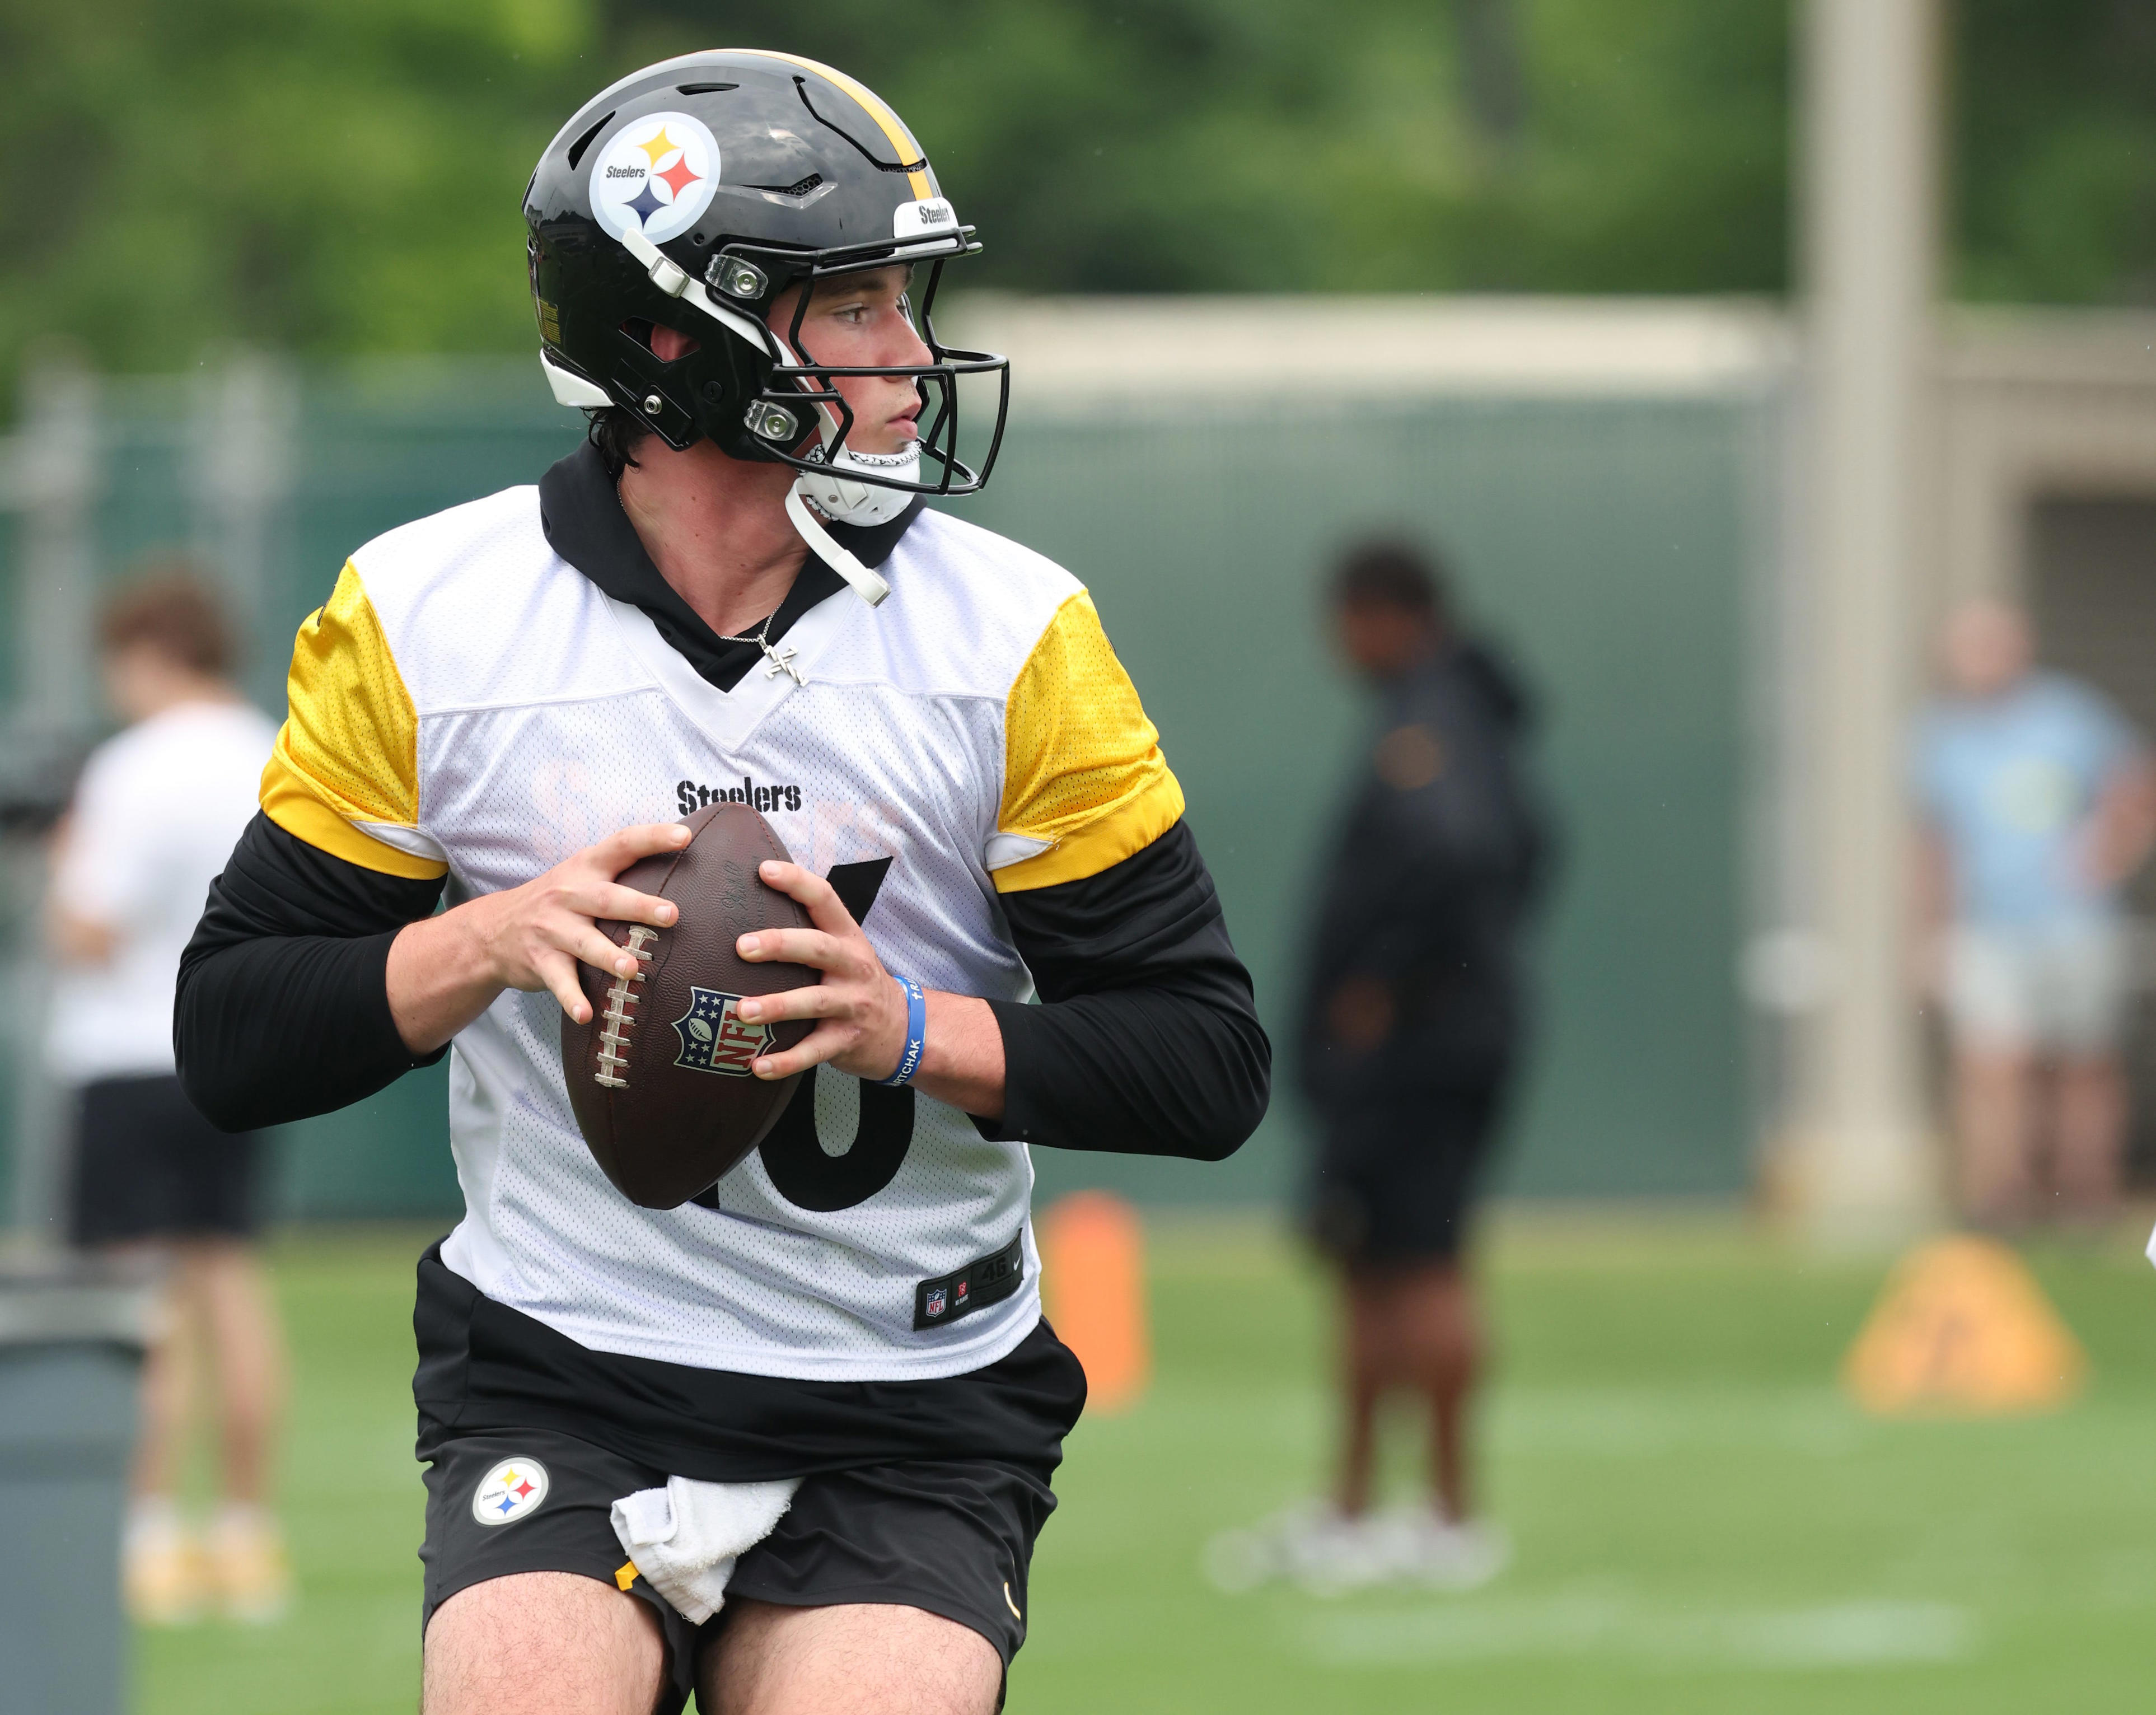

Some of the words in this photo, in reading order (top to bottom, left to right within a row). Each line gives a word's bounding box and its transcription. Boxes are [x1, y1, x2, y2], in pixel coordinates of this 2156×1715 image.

[606, 165, 646, 179] Steelers
[919, 203, 950, 225] Steeler
[982, 1256, 1006, 1282] 46
[929, 1300, 943, 1314] NFL
[483, 1490, 506, 1501] Steelers
